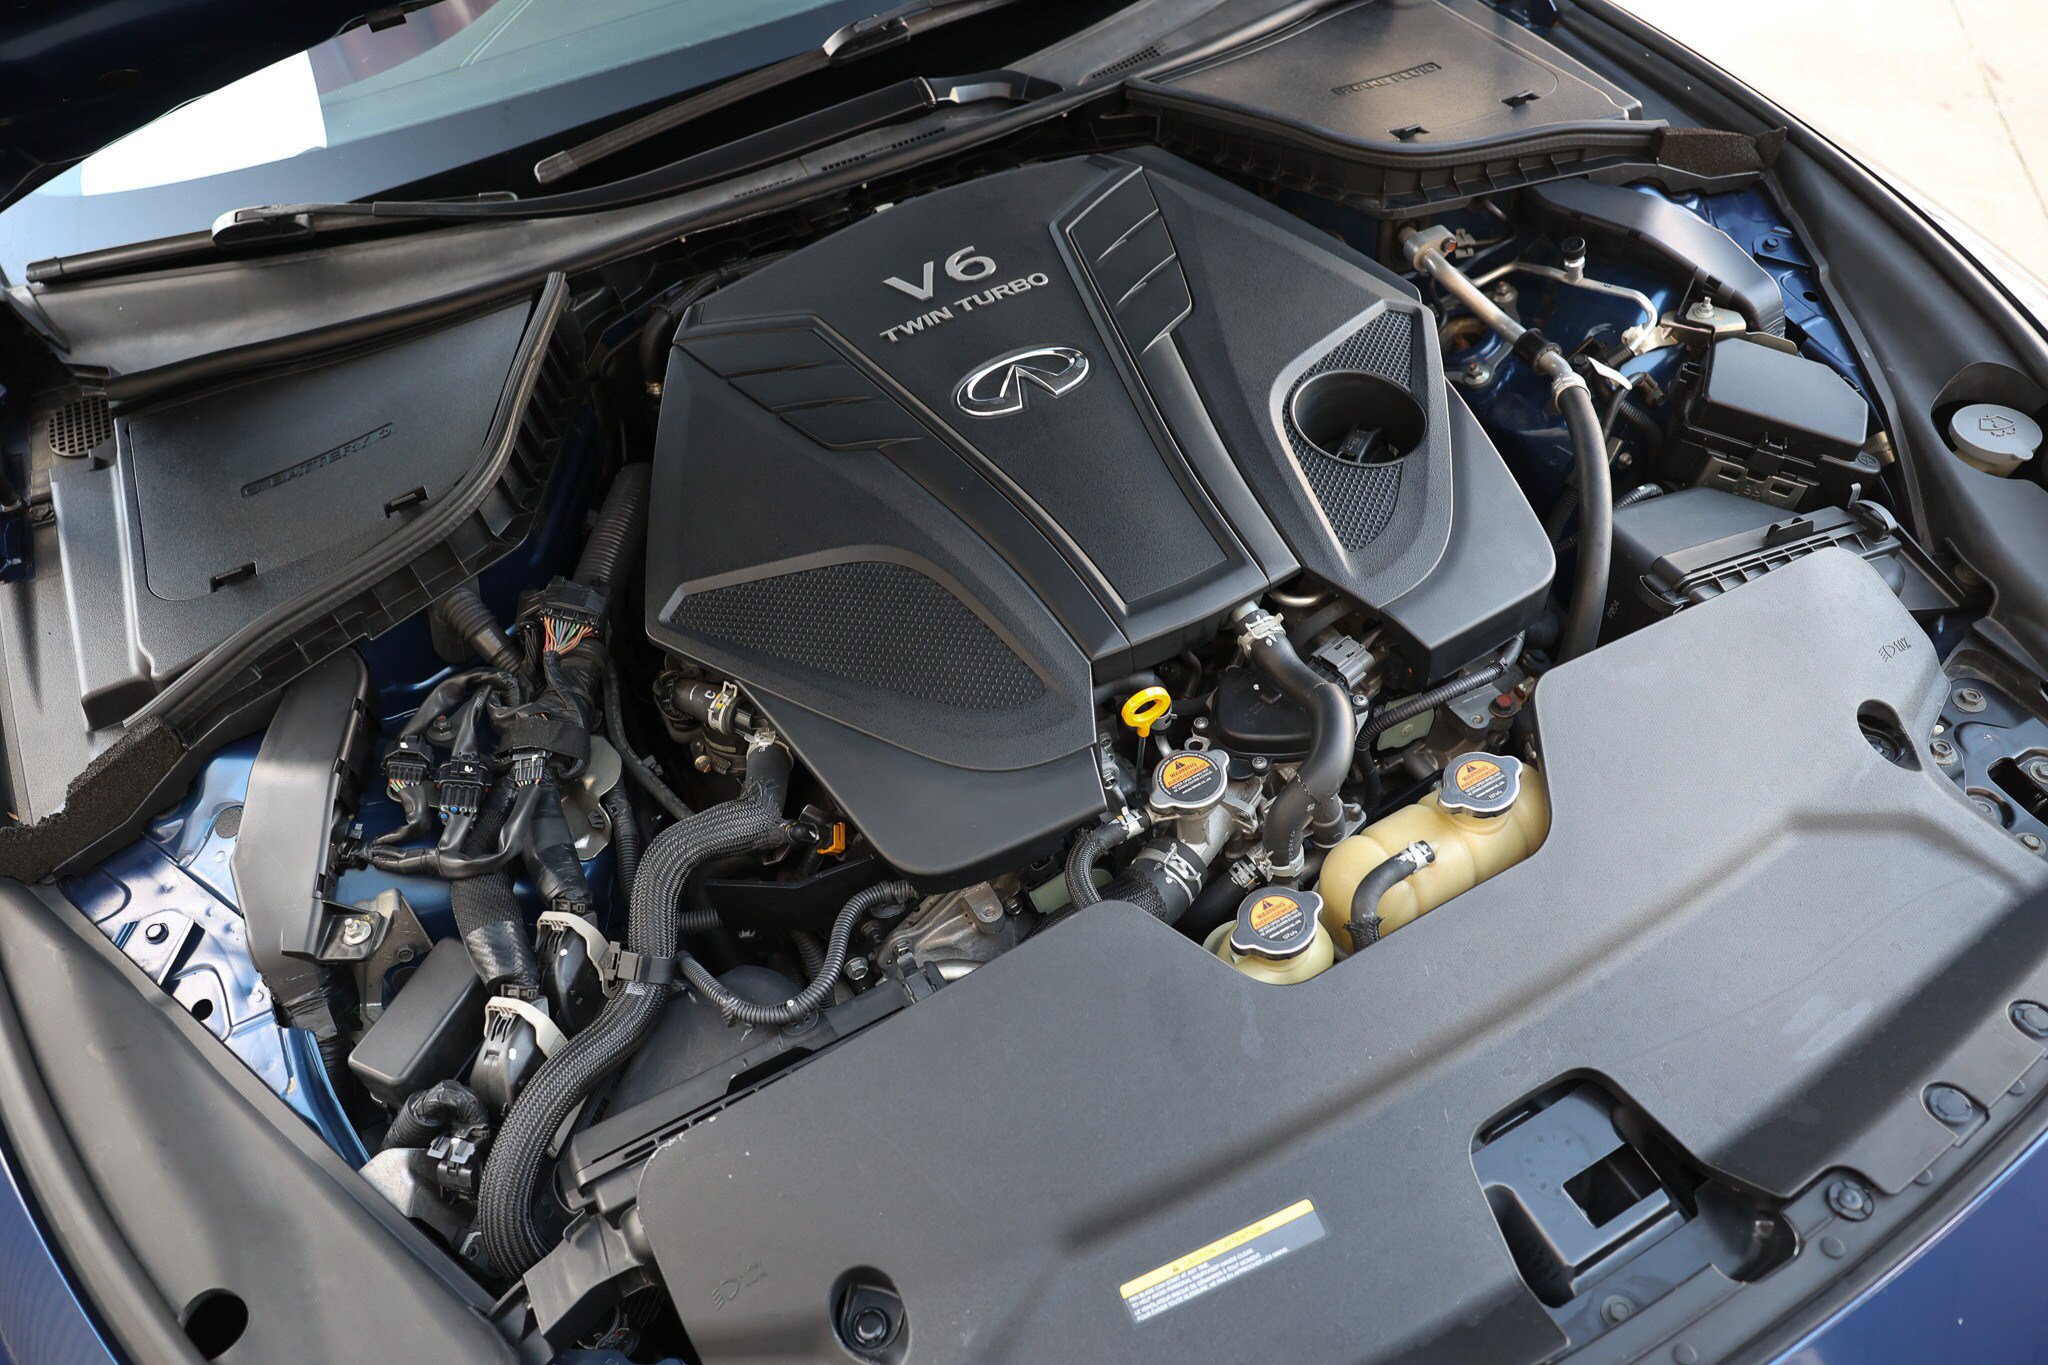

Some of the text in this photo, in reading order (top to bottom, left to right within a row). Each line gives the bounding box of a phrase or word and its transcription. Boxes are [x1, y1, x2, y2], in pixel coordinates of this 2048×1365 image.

[1393, 64, 1437, 82] FLUID
[882, 245, 997, 301] V6
[879, 272, 1049, 343] TWIN TURBO
[270, 435, 370, 487] BATTERY
[1170, 763, 1196, 778] WARNING
[1463, 766, 1488, 781] WARNING
[1256, 902, 1286, 919] WARNING
[1183, 1249, 1217, 1266] CAUTION
[1223, 1226, 1263, 1247] ATTENTION
